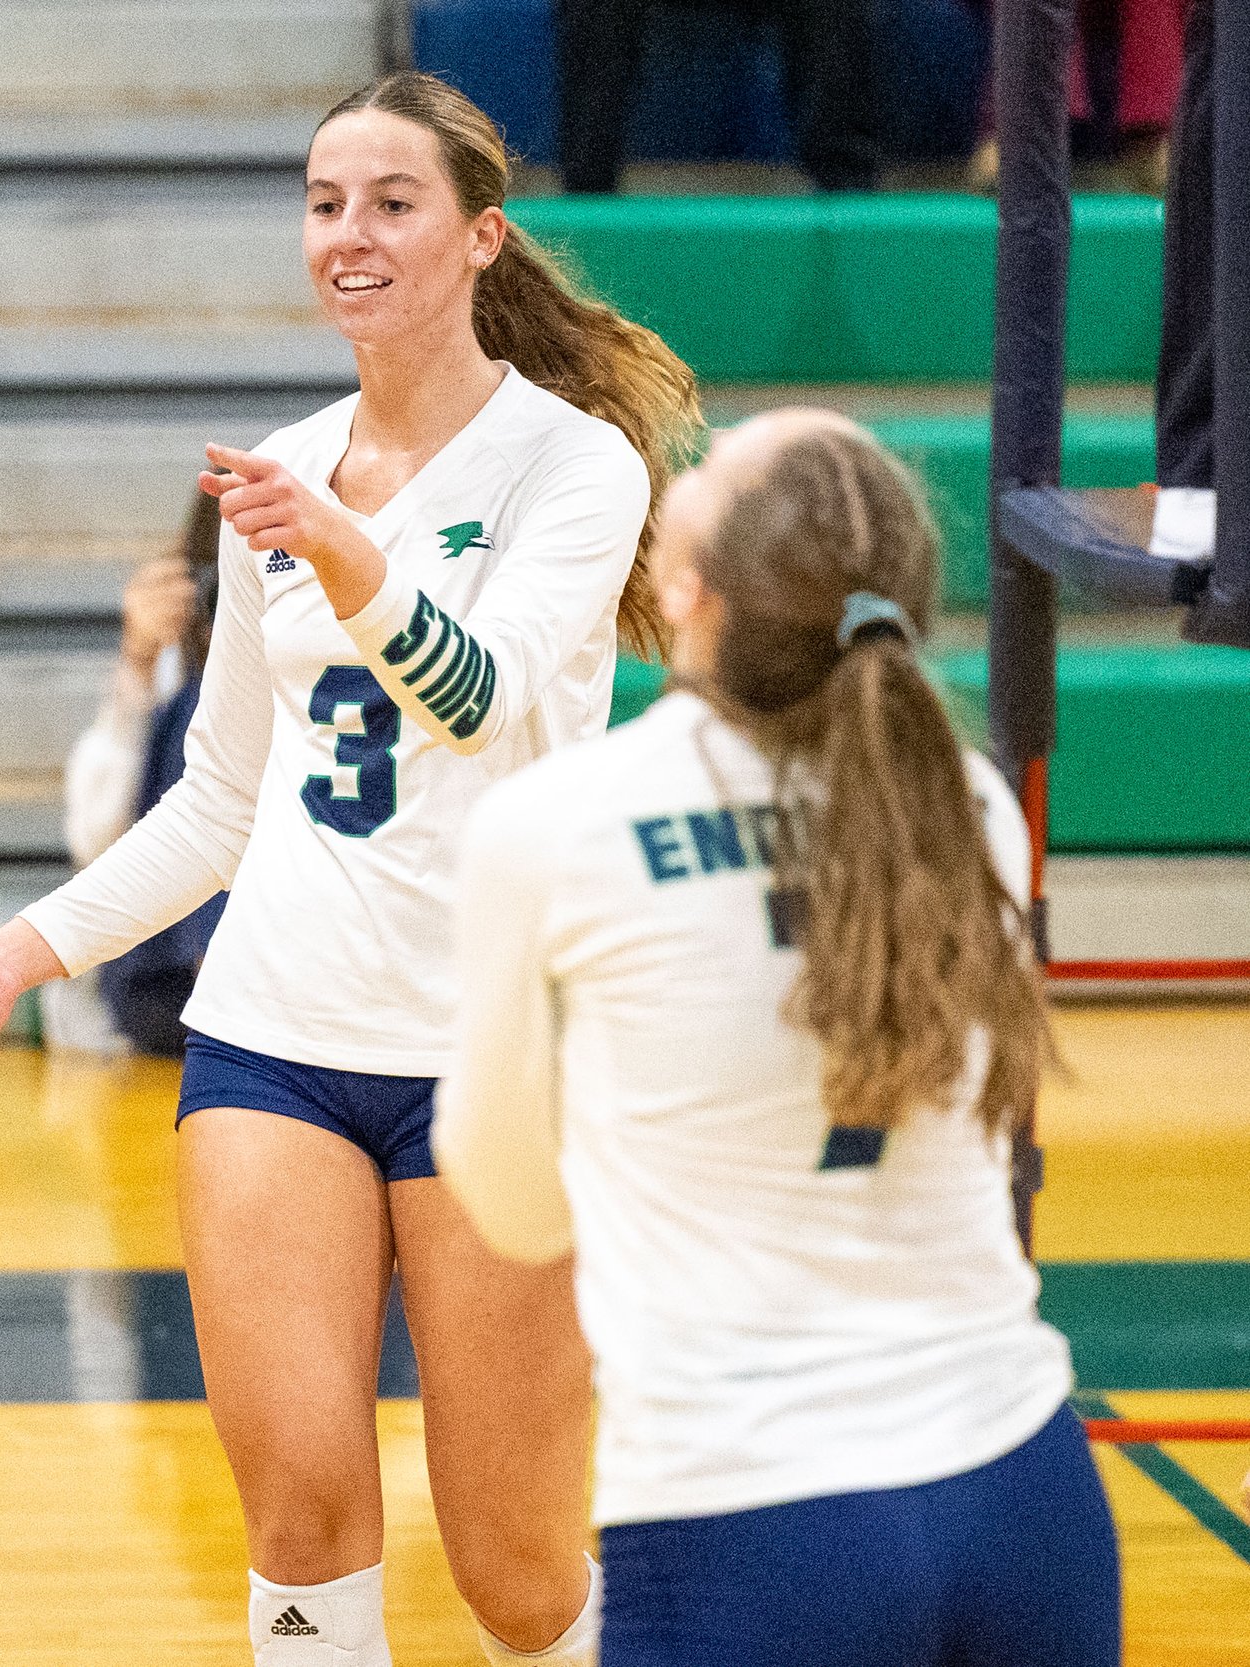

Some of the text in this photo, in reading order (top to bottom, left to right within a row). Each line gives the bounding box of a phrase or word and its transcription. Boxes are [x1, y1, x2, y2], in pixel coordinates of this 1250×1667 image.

[266, 559, 296, 574] adidas
[380, 588, 496, 741] GULLS
[299, 664, 402, 839] 3
[630, 803, 799, 883] END
[270, 1624, 319, 1636] adidas
